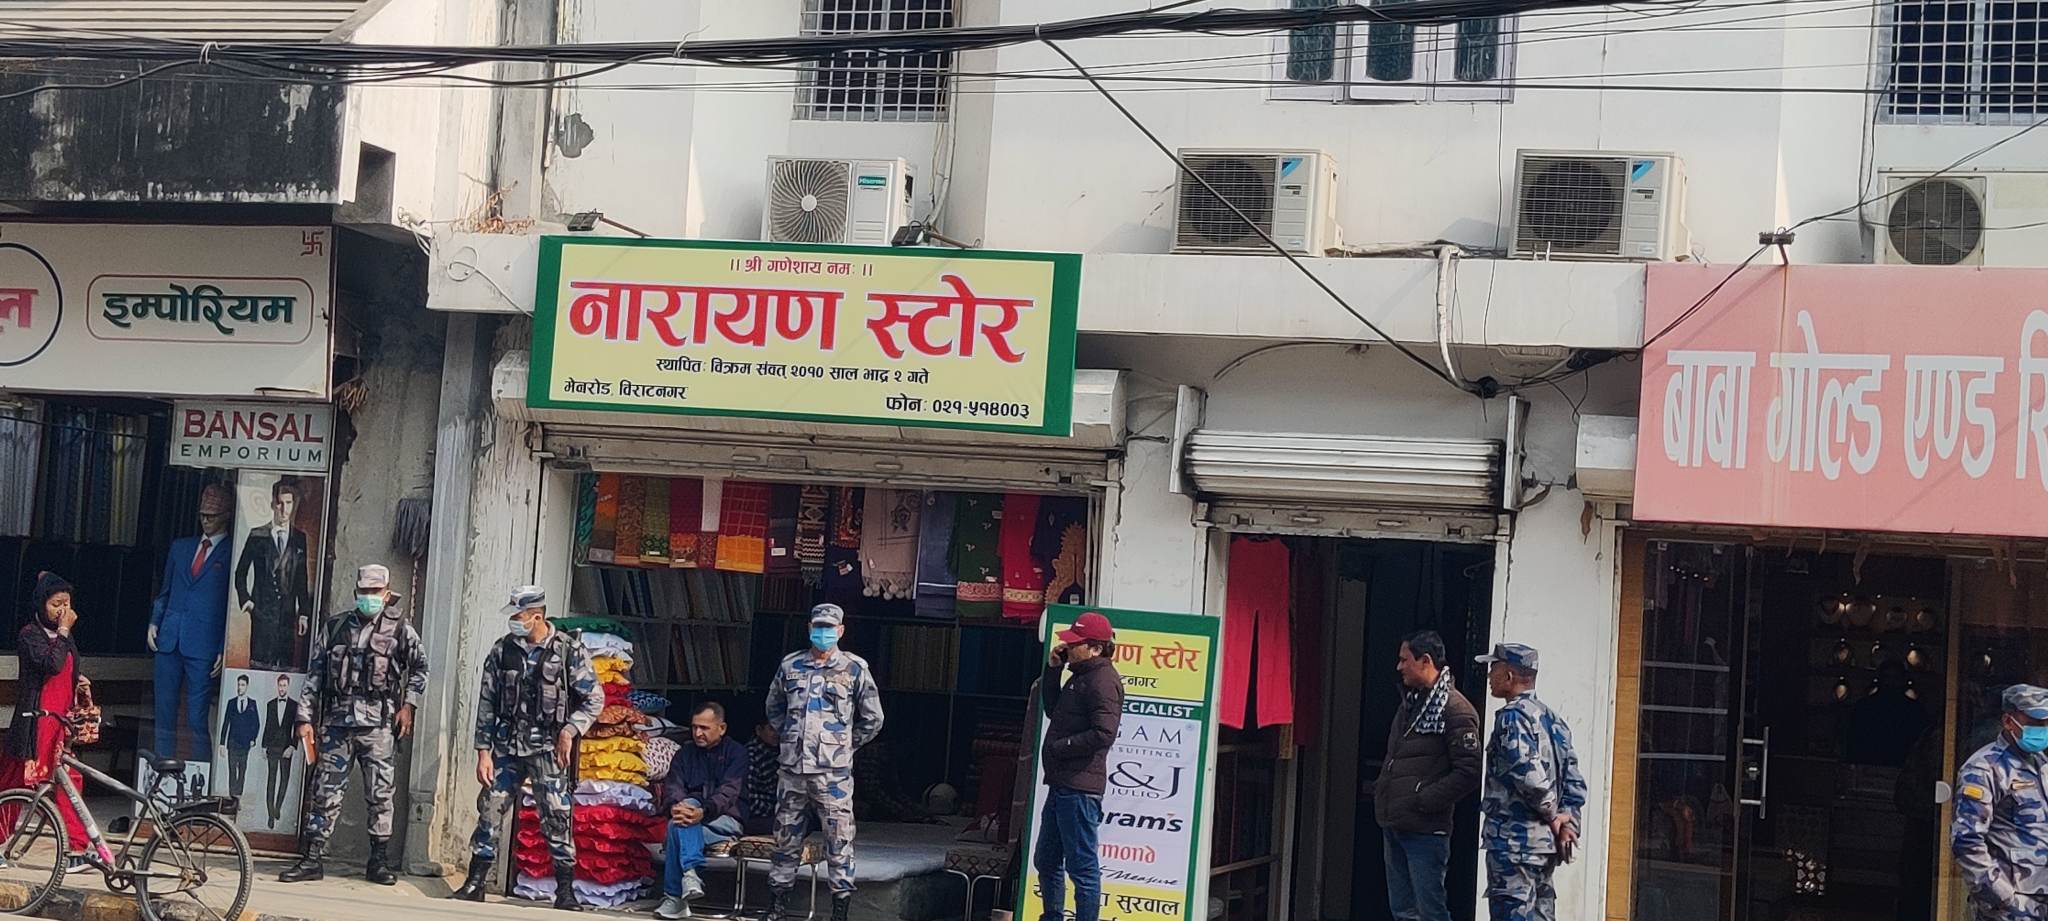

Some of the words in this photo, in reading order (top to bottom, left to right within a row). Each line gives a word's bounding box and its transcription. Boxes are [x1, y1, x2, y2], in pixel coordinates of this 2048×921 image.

[745, 256, 761, 272] श्री
[767, 256, 822, 274] गणेशाय
[102, 283, 298, 335] इम्पोरियम
[569, 280, 845, 350] नारायण
[866, 274, 1034, 363] स्टोर
[711, 357, 752, 374] विक्रम
[756, 361, 787, 379] संवत्
[790, 365, 824, 378] २०१०
[829, 366, 859, 380] साल
[863, 368, 890, 382] भाद्र
[894, 370, 902, 382] २
[907, 368, 930, 384] गते
[620, 379, 689, 399] विराटनगर
[1663, 350, 1756, 468] बाबा
[1766, 310, 1891, 480] गोल्ड
[1904, 354, 2004, 479] एण्ड
[932, 399, 1030, 418] ०२१-५१४००३
[184, 409, 324, 443] BANSAL
[181, 444, 322, 462] EMPORIUM
[1151, 641, 1202, 672] स्टोर
[1120, 675, 1159, 688] टनगर
[1122, 701, 1194, 718] ECIALIST
[1118, 747, 1180, 758] SUITINGS
[1098, 811, 1183, 832] ram's
[1099, 843, 1156, 863] mond
[1116, 894, 1181, 916] सुरवाल
